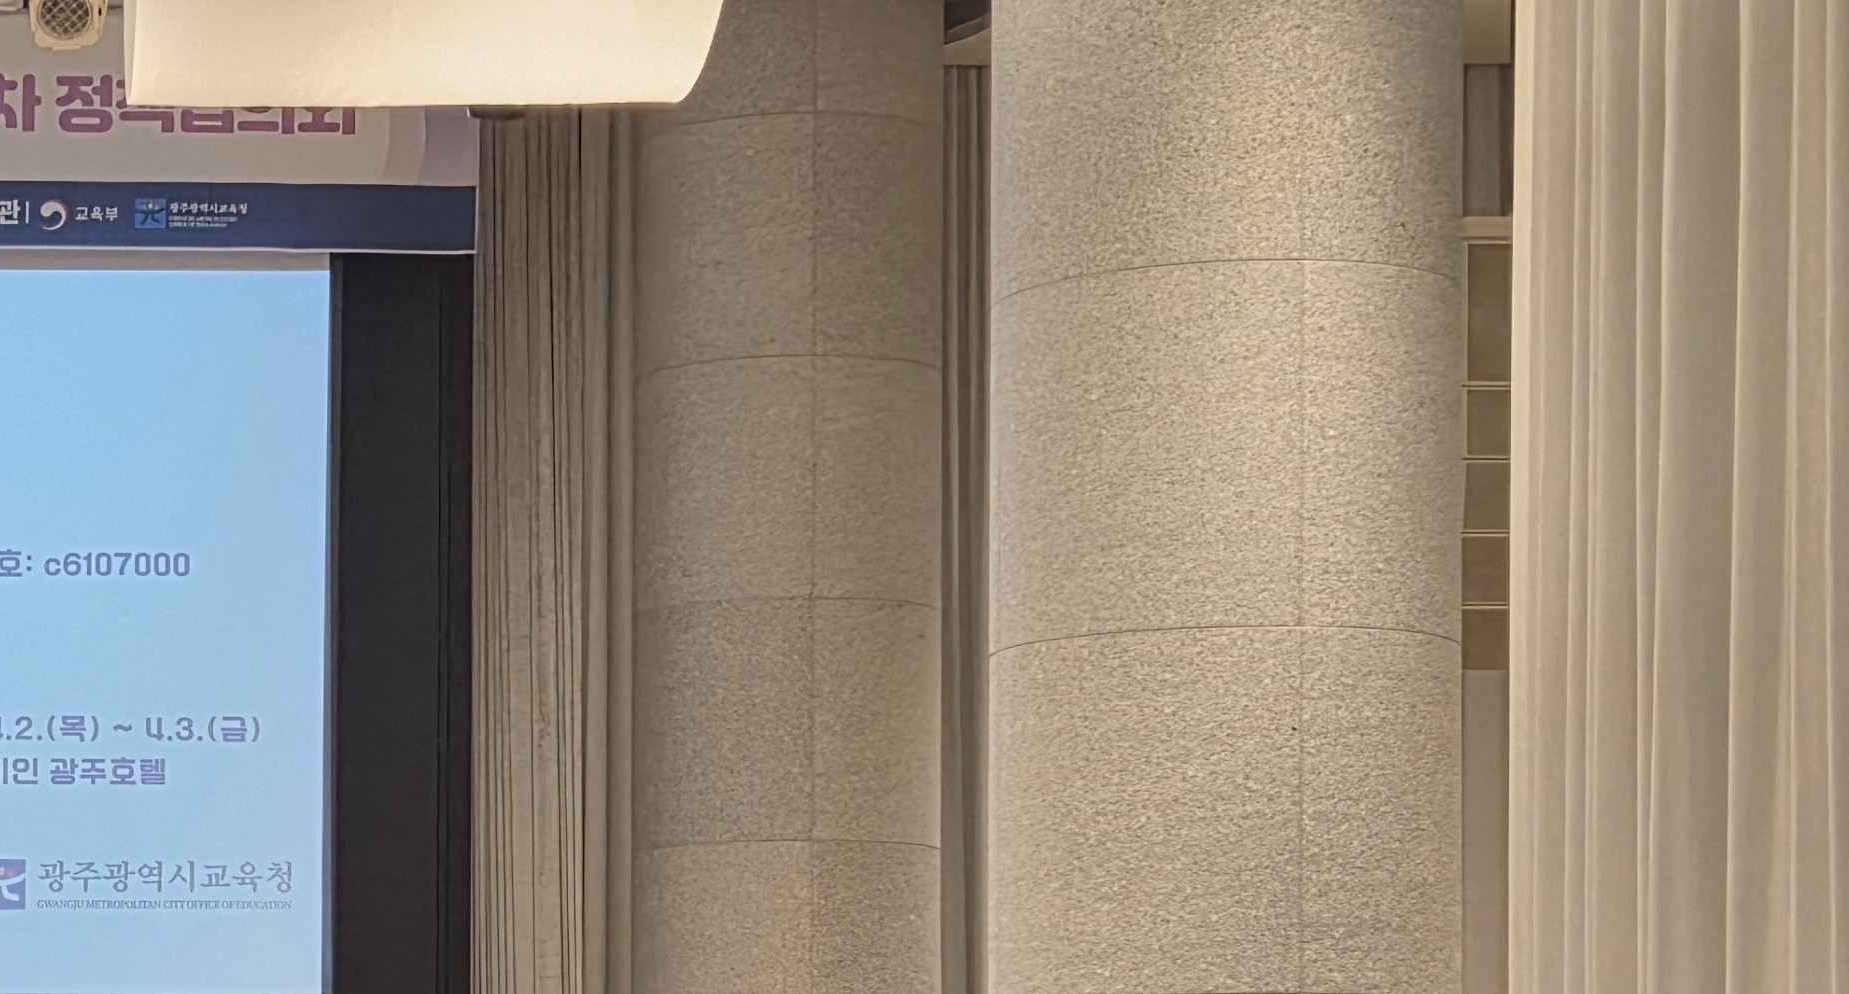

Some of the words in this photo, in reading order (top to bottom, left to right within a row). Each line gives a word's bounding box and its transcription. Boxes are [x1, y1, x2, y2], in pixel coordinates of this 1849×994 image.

[76, 207, 118, 221] 교육부
[44, 553, 190, 576] c6107000
[146, 716, 259, 742] 4.3.(금)
[51, 757, 165, 785] 광주호텔
[38, 860, 291, 892] 광주광역시교육청
[37, 900, 83, 910] GWANGJU
[87, 900, 160, 909] METROPOLITAN
[164, 900, 185, 909] CITY
[236, 900, 291, 909] EDUCATION
